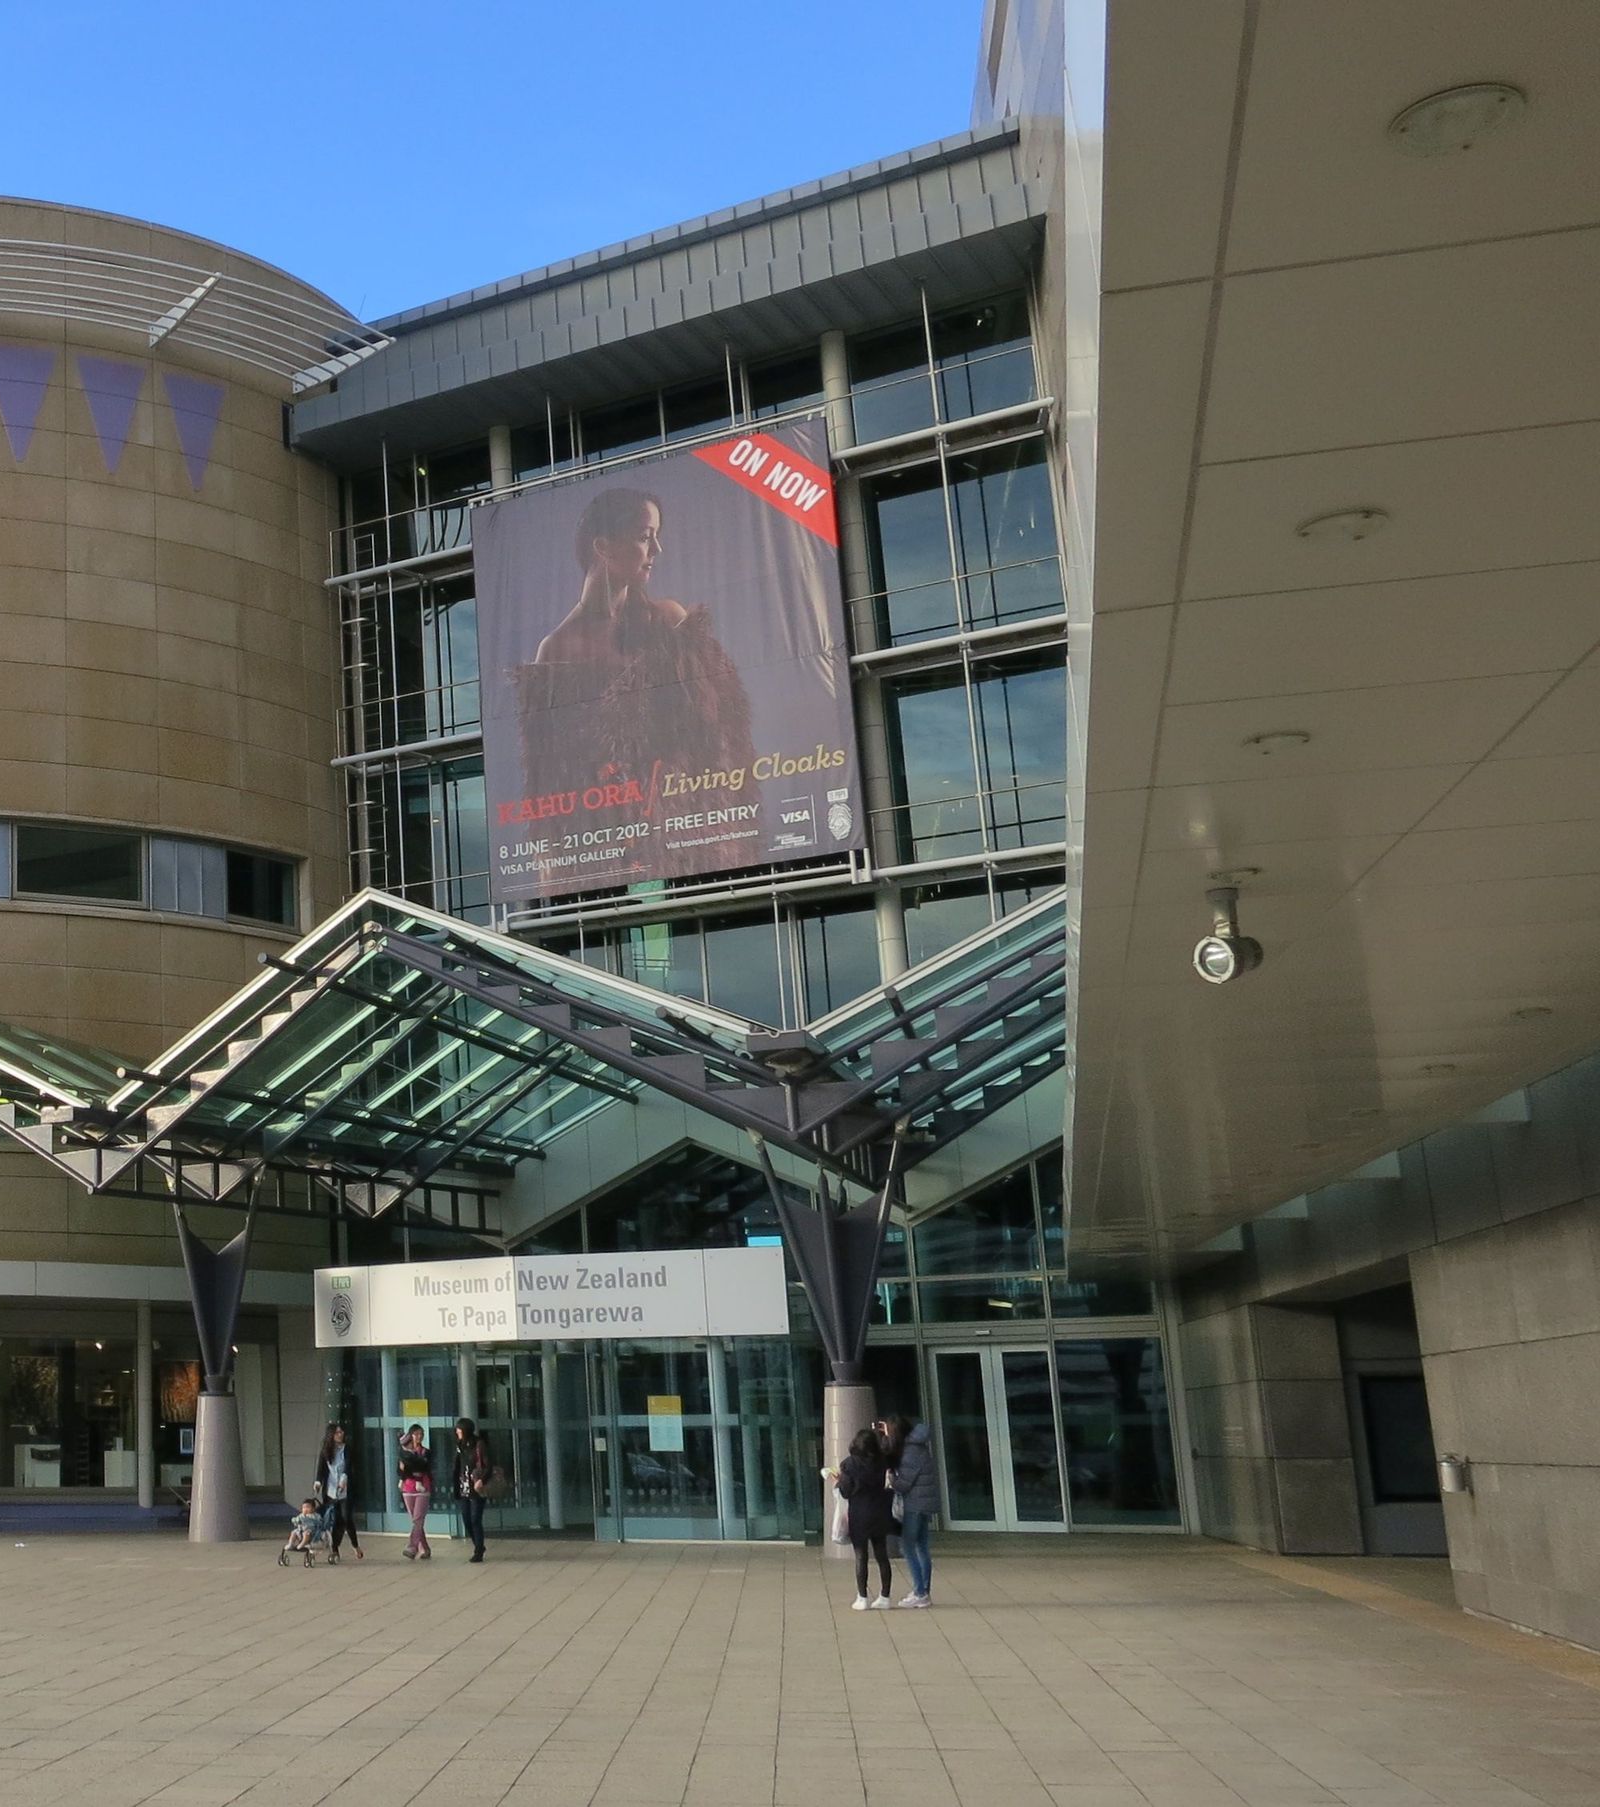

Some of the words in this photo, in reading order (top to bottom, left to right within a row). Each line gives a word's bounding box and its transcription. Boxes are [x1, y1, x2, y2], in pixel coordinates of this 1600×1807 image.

[728, 439, 770, 477] ON
[763, 461, 827, 512] NOW
[662, 767, 746, 797] Living
[752, 744, 845, 781] Cloaks
[496, 791, 577, 826] KAHU
[583, 780, 644, 810] ORA
[780, 810, 810, 824] VISA
[500, 846, 508, 859] 8
[512, 839, 549, 857] JUNE
[564, 834, 578, 849] 21
[582, 828, 612, 845] OCT
[616, 822, 650, 841] 2012
[665, 813, 704, 832] FREE
[707, 803, 760, 826] ENTRY
[500, 863, 526, 875] VISA
[526, 855, 577, 872] PLATINUM
[579, 847, 627, 863] GALLERY
[414, 1276, 489, 1296] Museum
[494, 1270, 511, 1292] of
[517, 1270, 569, 1291] New
[576, 1265, 667, 1289] Zealand
[438, 1307, 457, 1328] Te
[463, 1306, 507, 1332] Papa
[518, 1303, 643, 1329] Tongarewa
